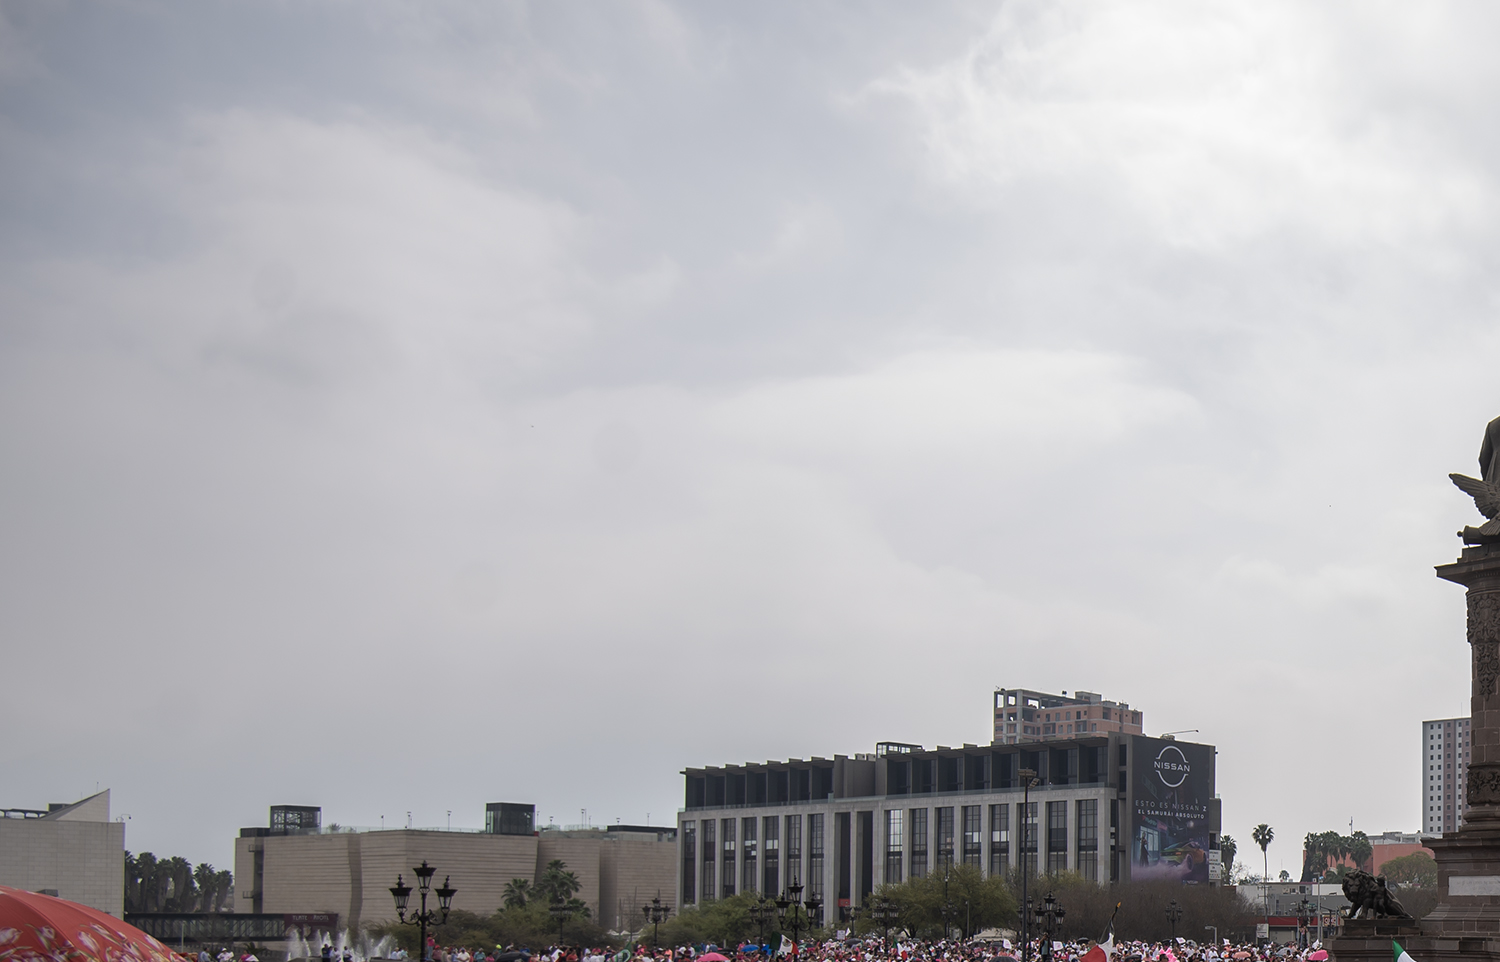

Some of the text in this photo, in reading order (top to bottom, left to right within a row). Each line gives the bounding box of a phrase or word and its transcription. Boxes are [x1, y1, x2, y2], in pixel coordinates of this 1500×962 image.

[1153, 761, 1191, 772] NISSAN
[1135, 799, 1156, 808] ESTO
[1172, 803, 1200, 812] NISSAN
[1175, 811, 1205, 820] ABSOLUTO
